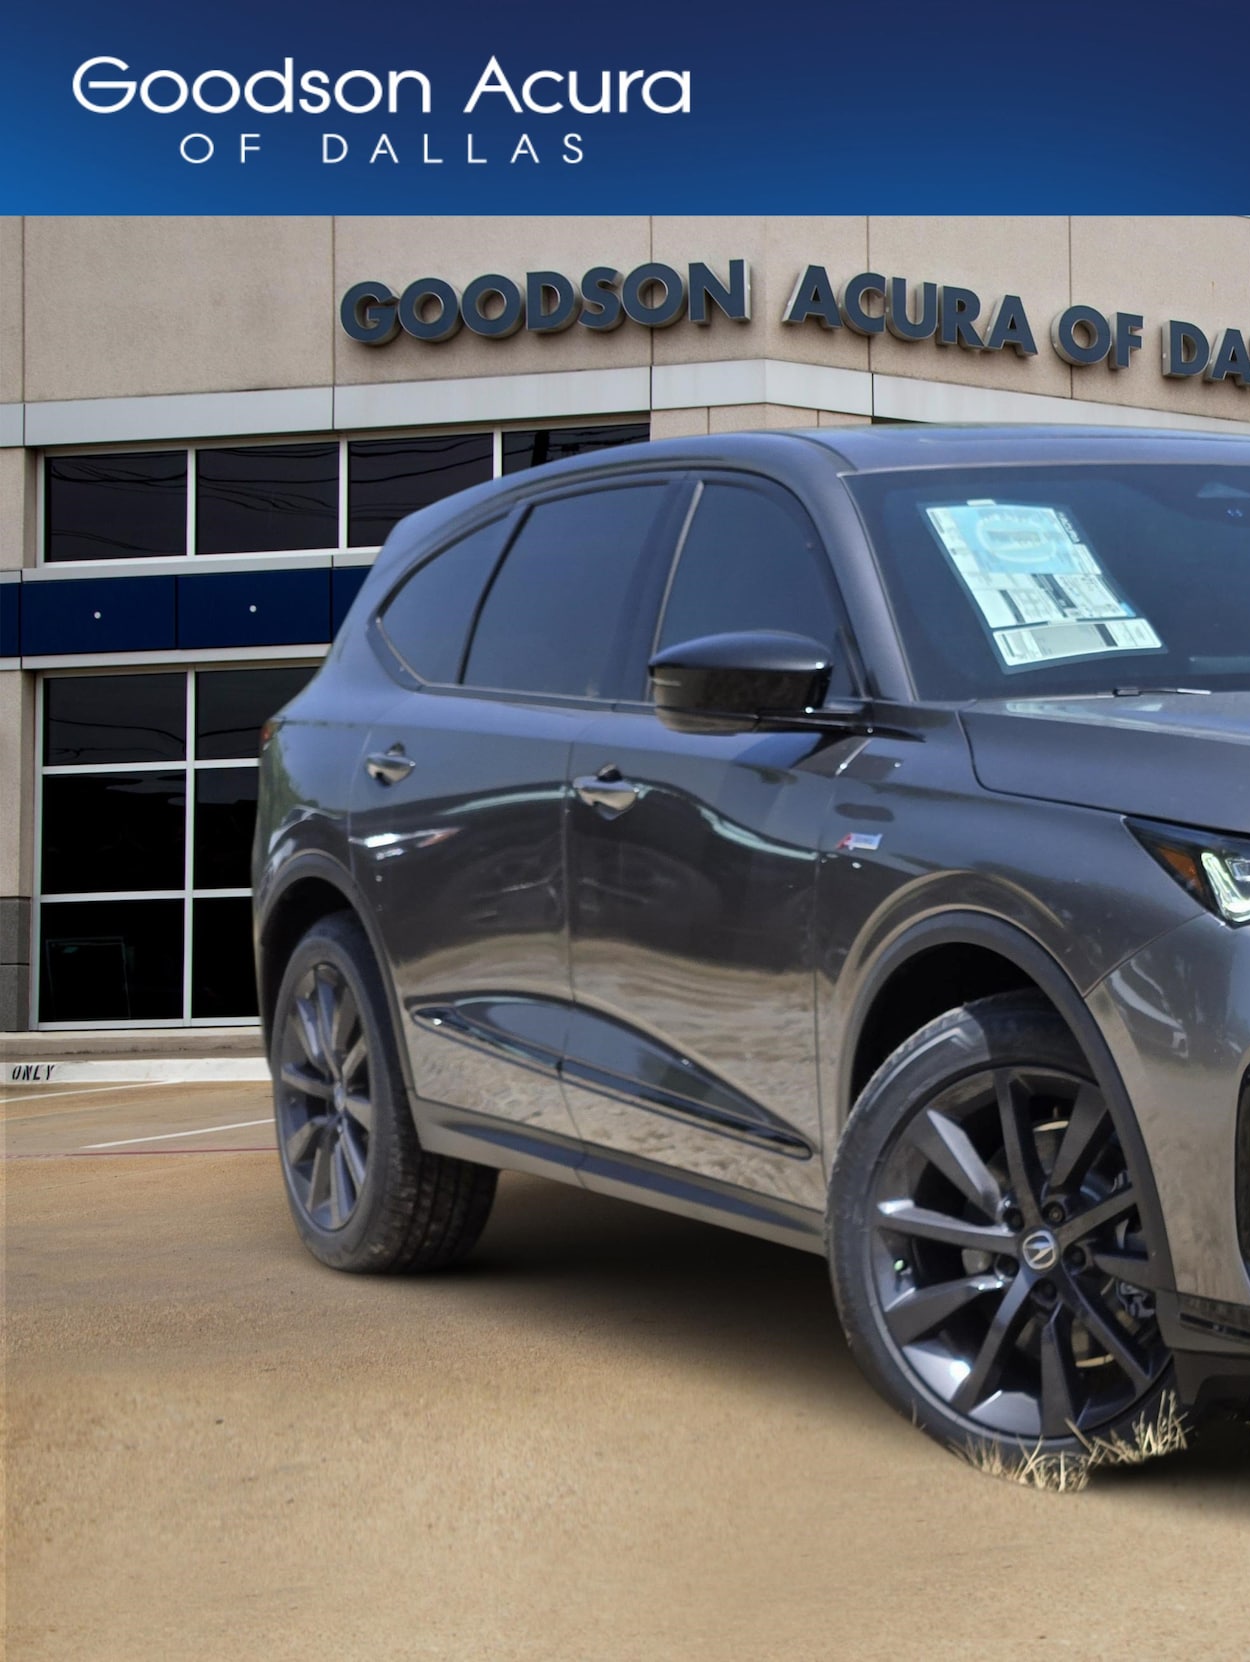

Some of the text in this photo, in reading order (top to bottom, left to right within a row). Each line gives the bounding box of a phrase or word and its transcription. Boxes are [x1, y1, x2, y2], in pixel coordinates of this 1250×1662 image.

[340, 259, 751, 346] GOODSON
[782, 264, 1038, 357] ACURA
[1051, 304, 1144, 371] OF
[12, 1065, 55, 1081] ONLY
